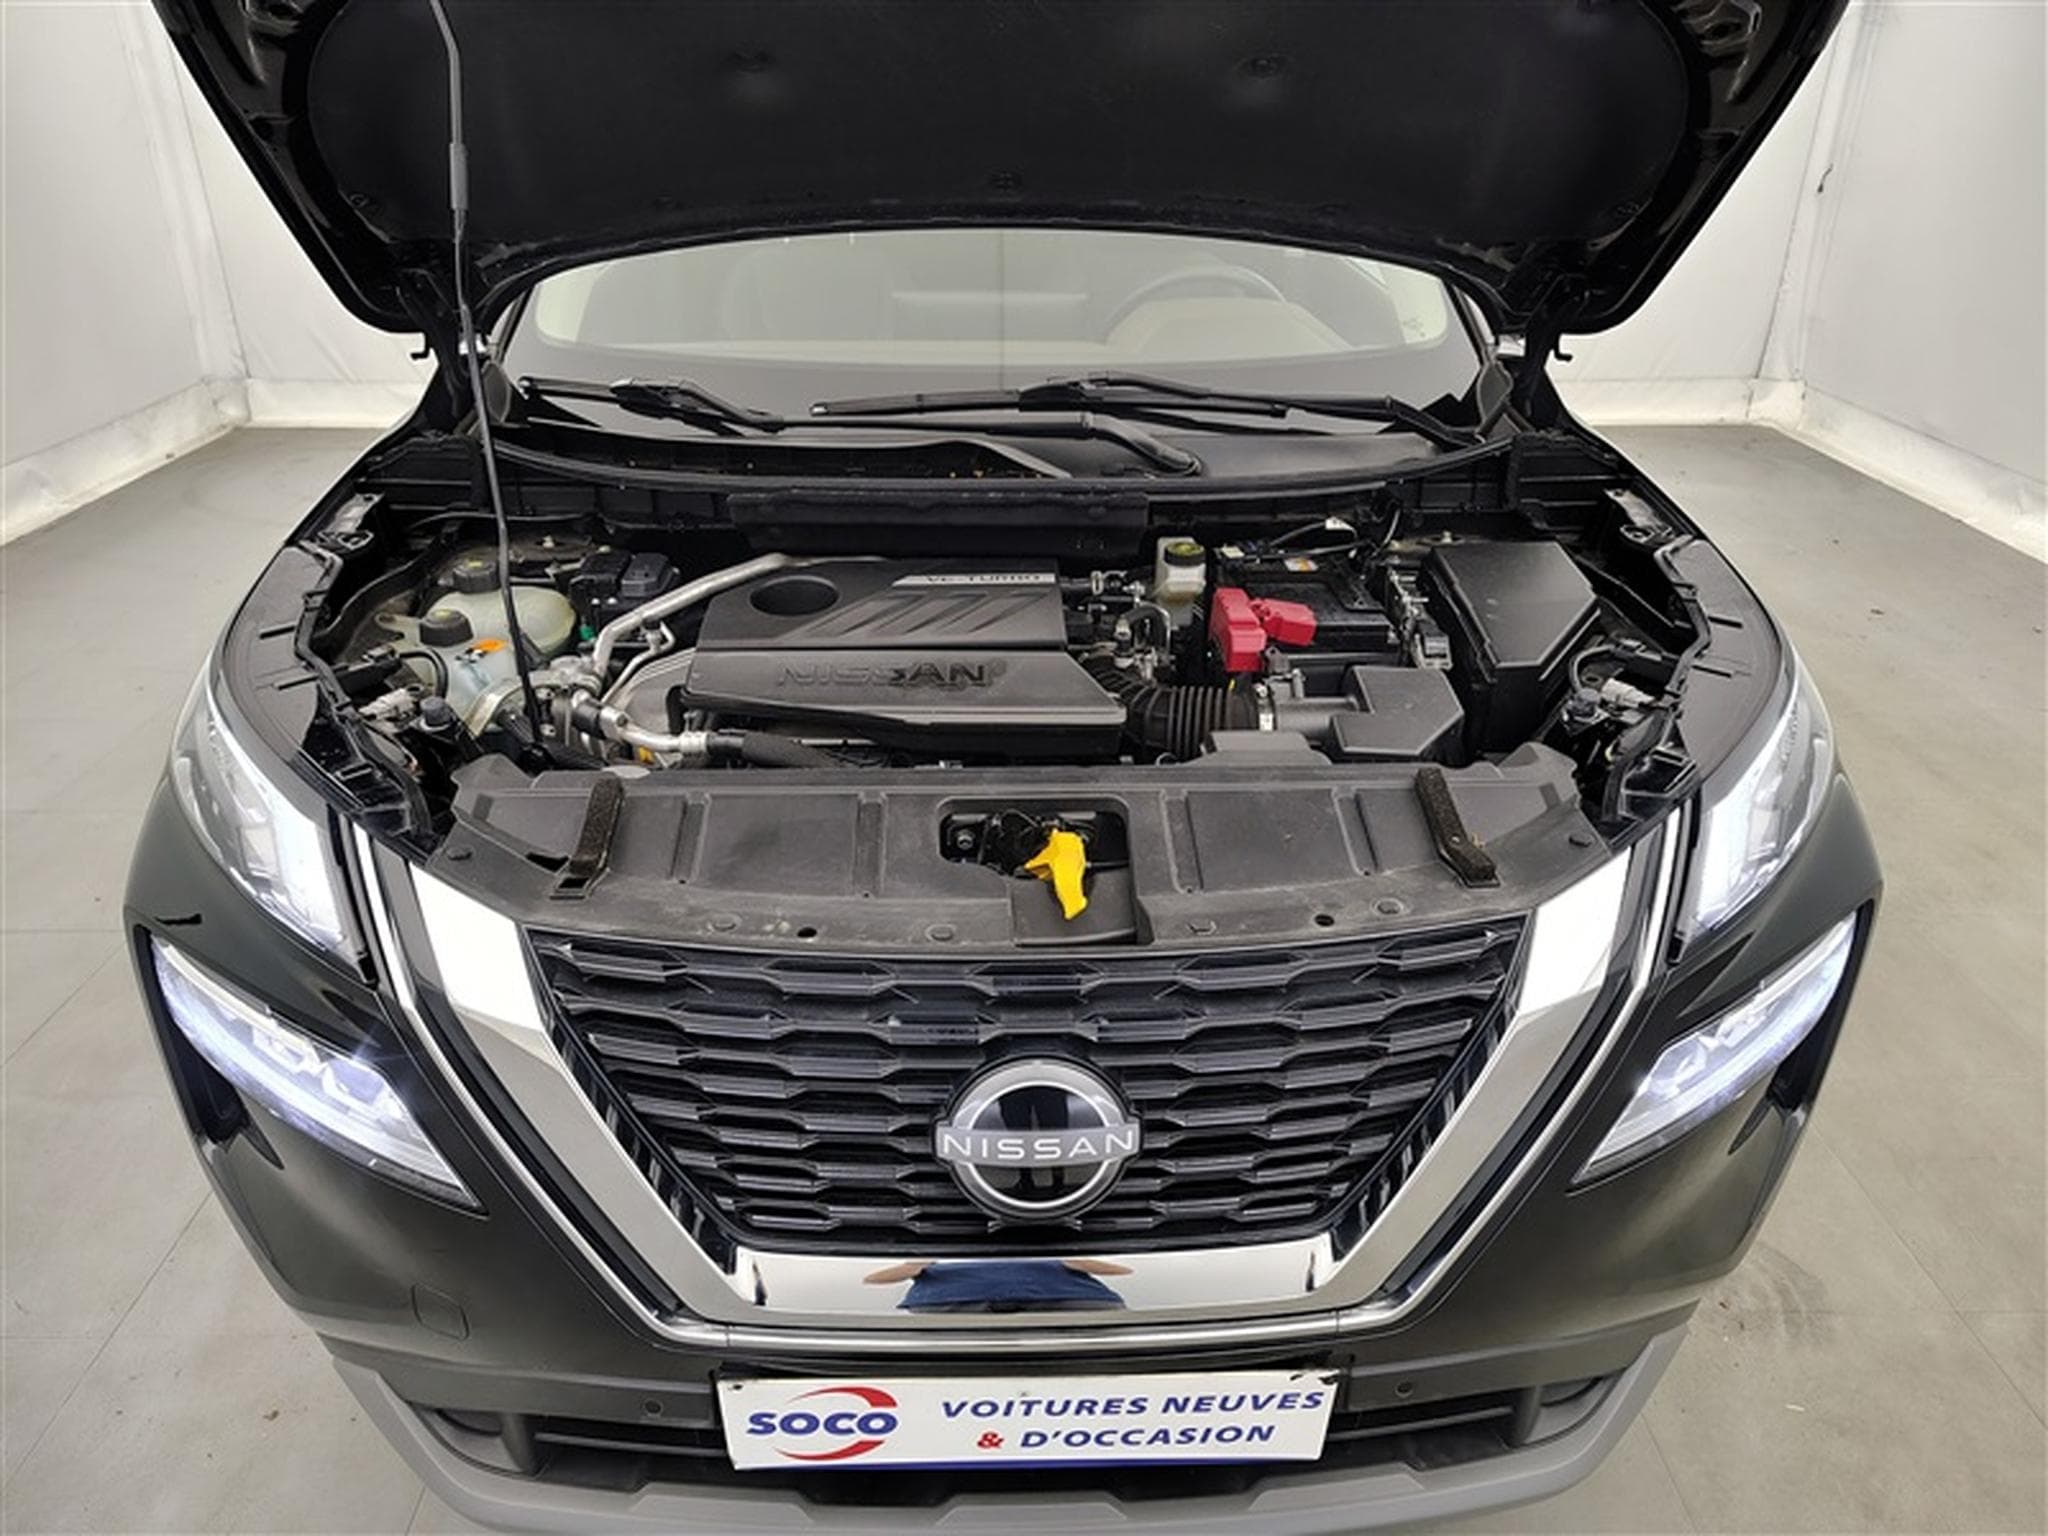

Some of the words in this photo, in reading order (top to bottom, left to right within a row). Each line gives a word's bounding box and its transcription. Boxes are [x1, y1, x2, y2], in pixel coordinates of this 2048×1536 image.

[778, 660, 989, 688] NISSAN
[942, 1130, 1133, 1160] NISSAN
[941, 1396, 1149, 1419] VOITURES
[1161, 1391, 1325, 1414] NEUVES
[746, 1411, 898, 1436] SOCO
[976, 1431, 1004, 1450] &
[1020, 1425, 1276, 1448] D'OCCASION
